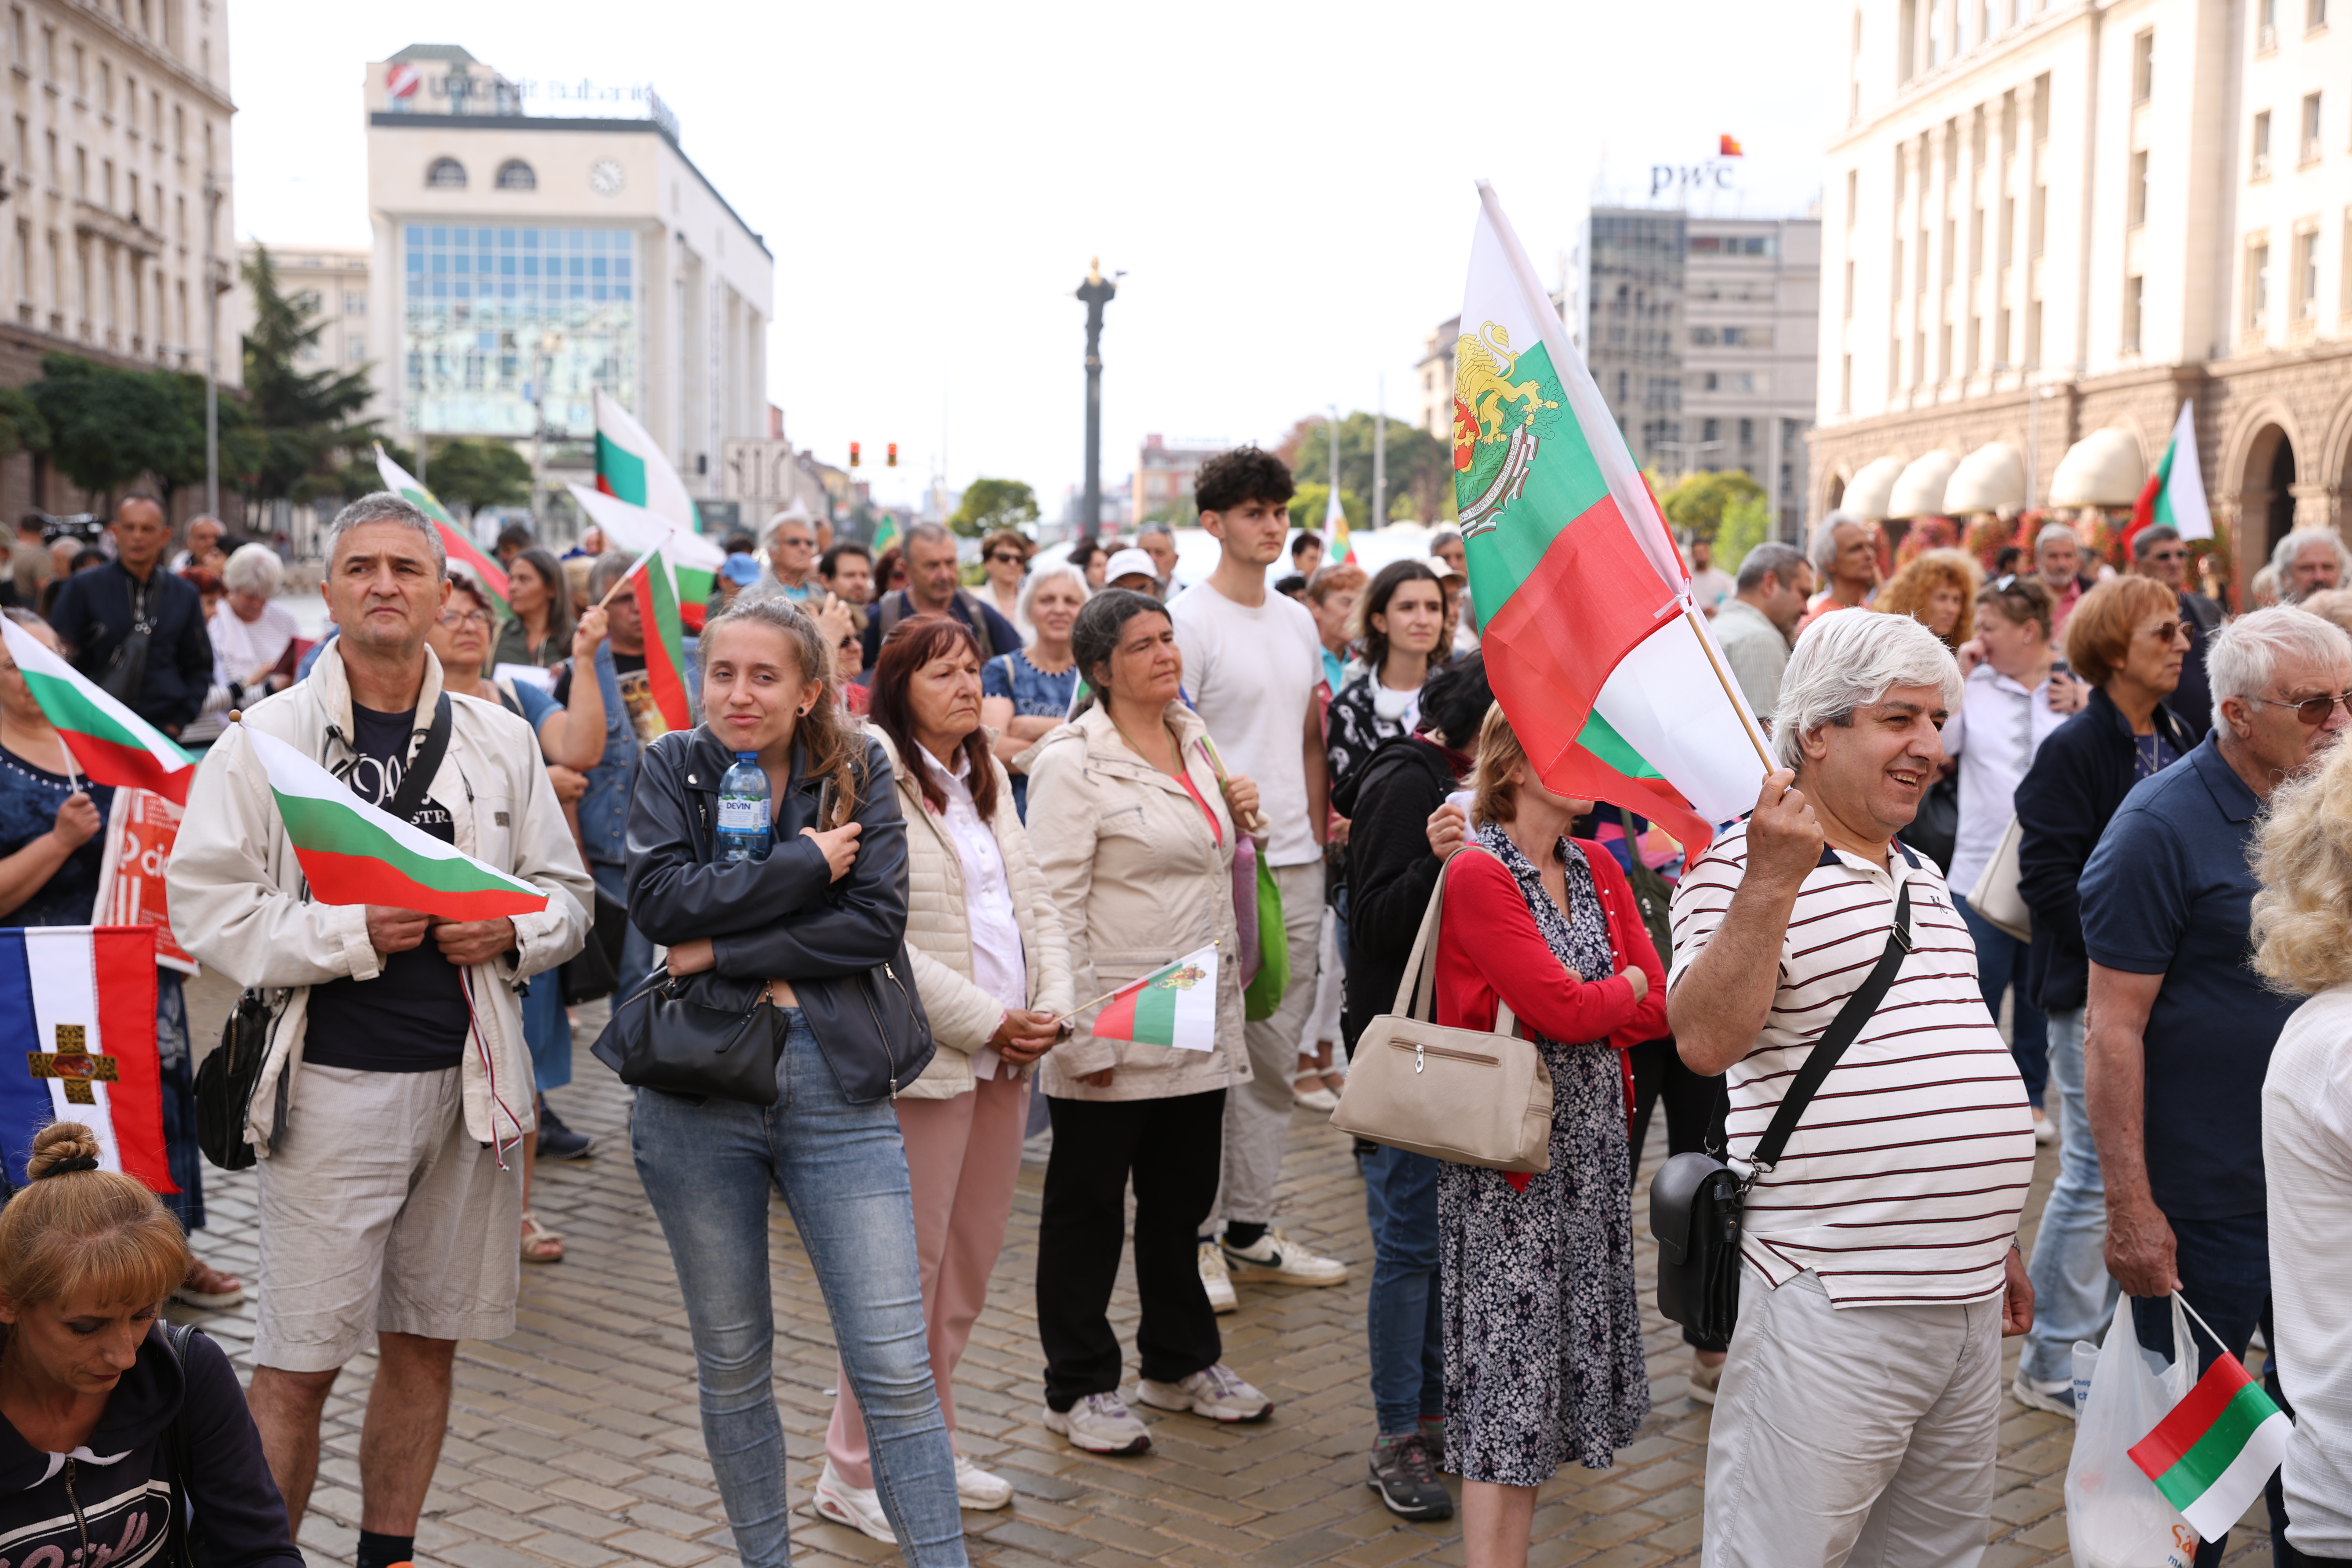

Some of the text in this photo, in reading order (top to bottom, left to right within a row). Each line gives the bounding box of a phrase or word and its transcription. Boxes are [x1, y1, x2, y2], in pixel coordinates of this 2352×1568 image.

[1651, 165, 1733, 197] pwc
[726, 802, 751, 810] DEVIN
[410, 809, 453, 825] STR
